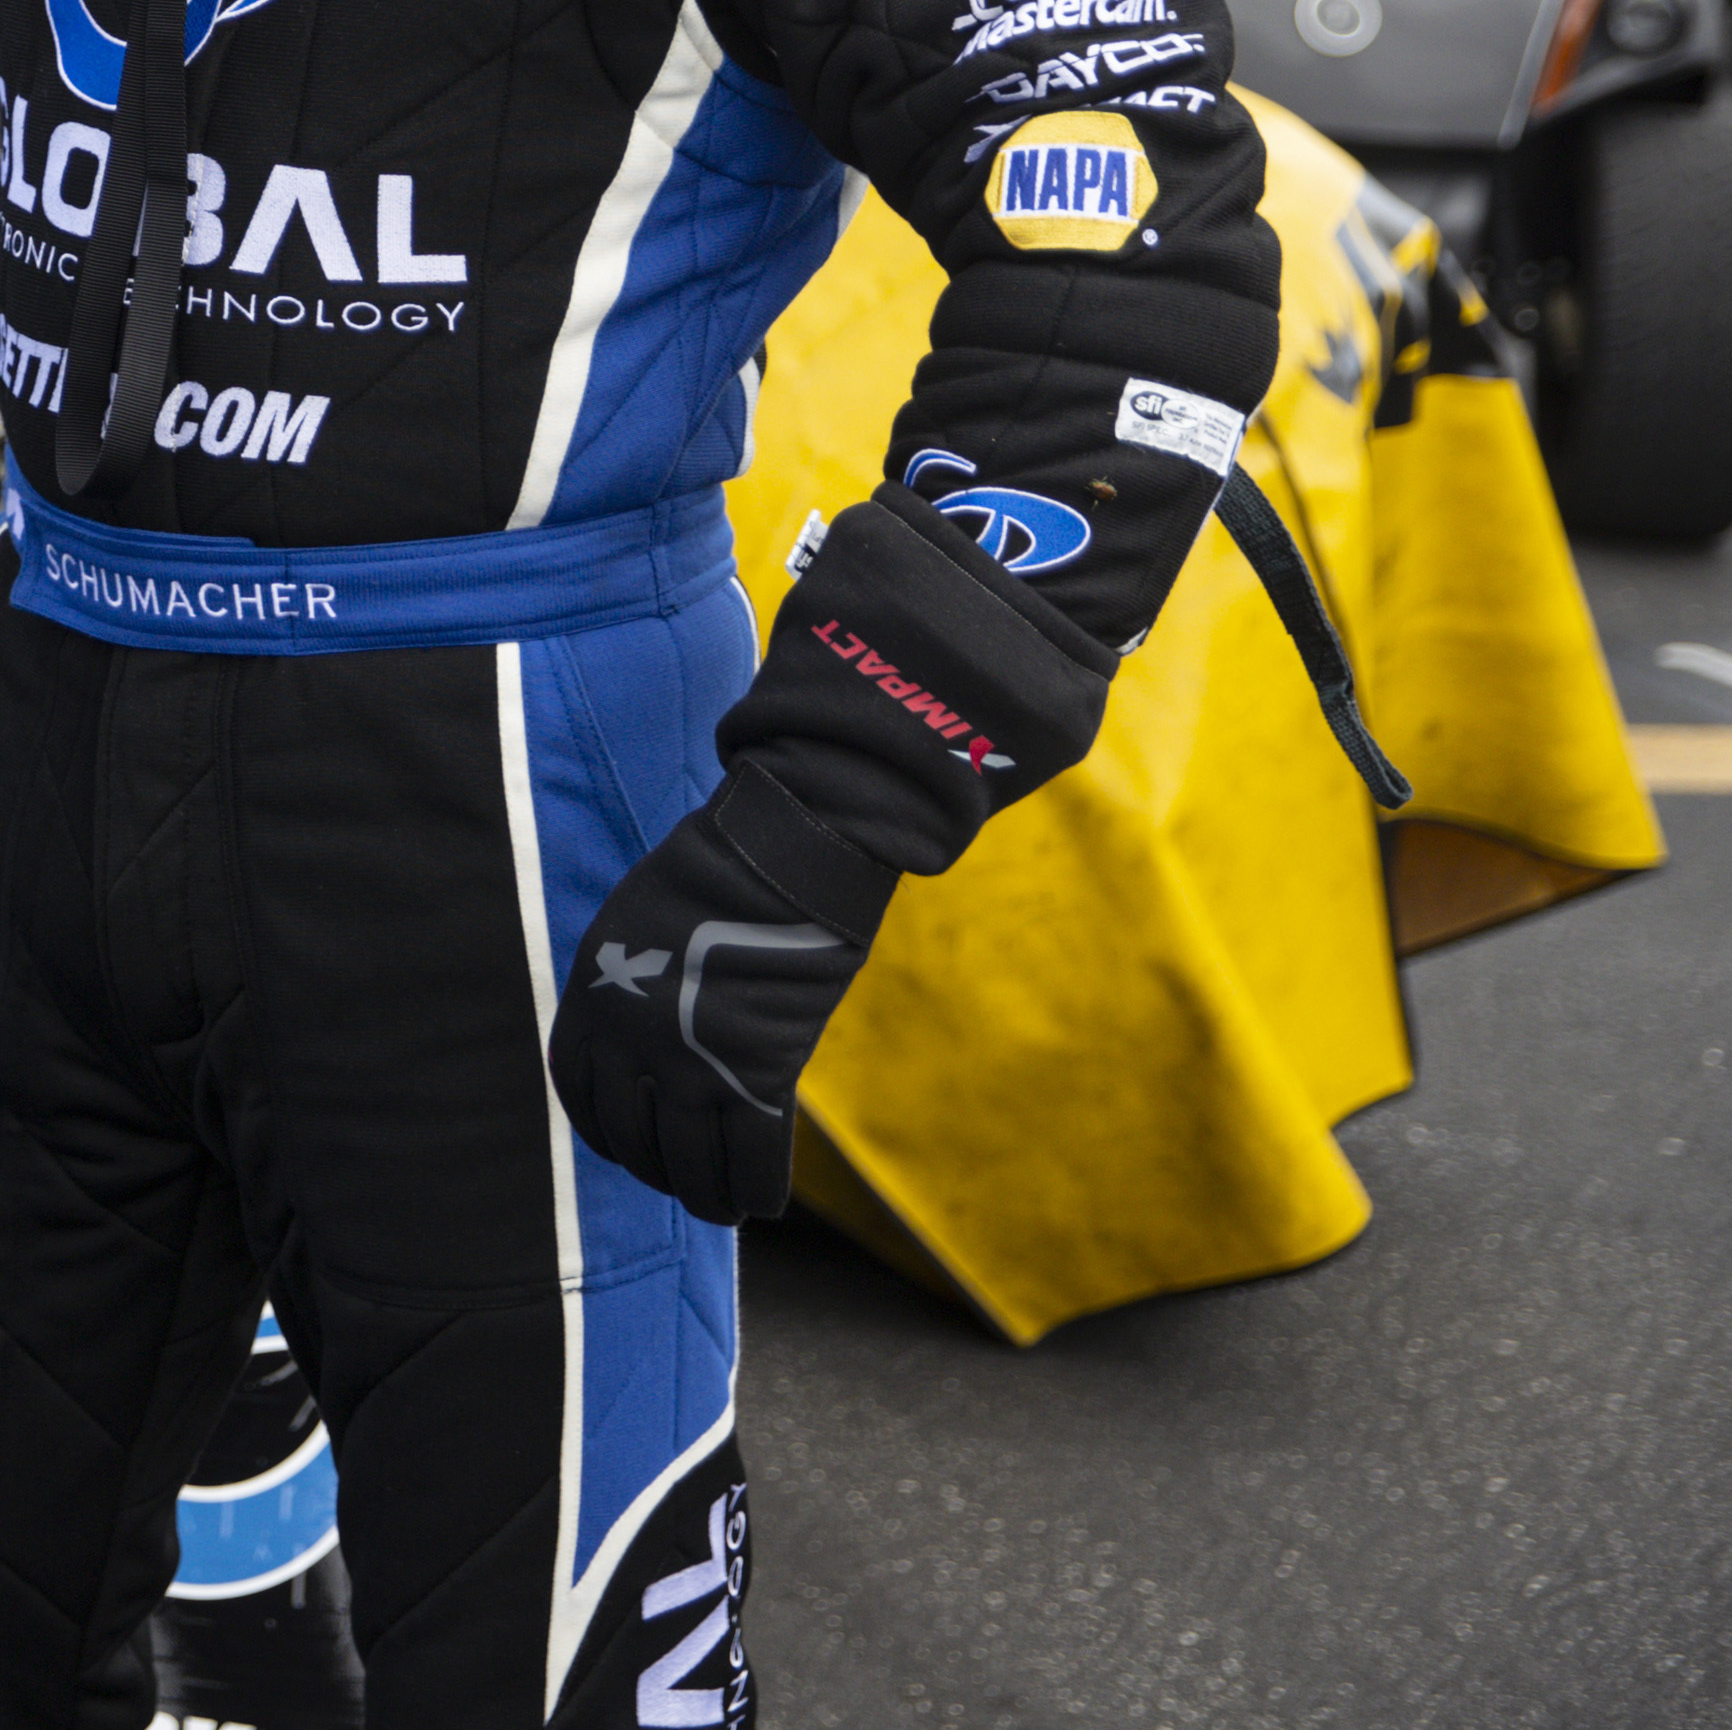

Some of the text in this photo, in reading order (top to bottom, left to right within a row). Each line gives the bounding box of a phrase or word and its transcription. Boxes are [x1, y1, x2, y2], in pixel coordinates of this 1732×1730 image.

[1007, 148, 1128, 218] NAPA
[45, 543, 337, 620] SCHUMACHER
[810, 619, 973, 740] IMPACT
